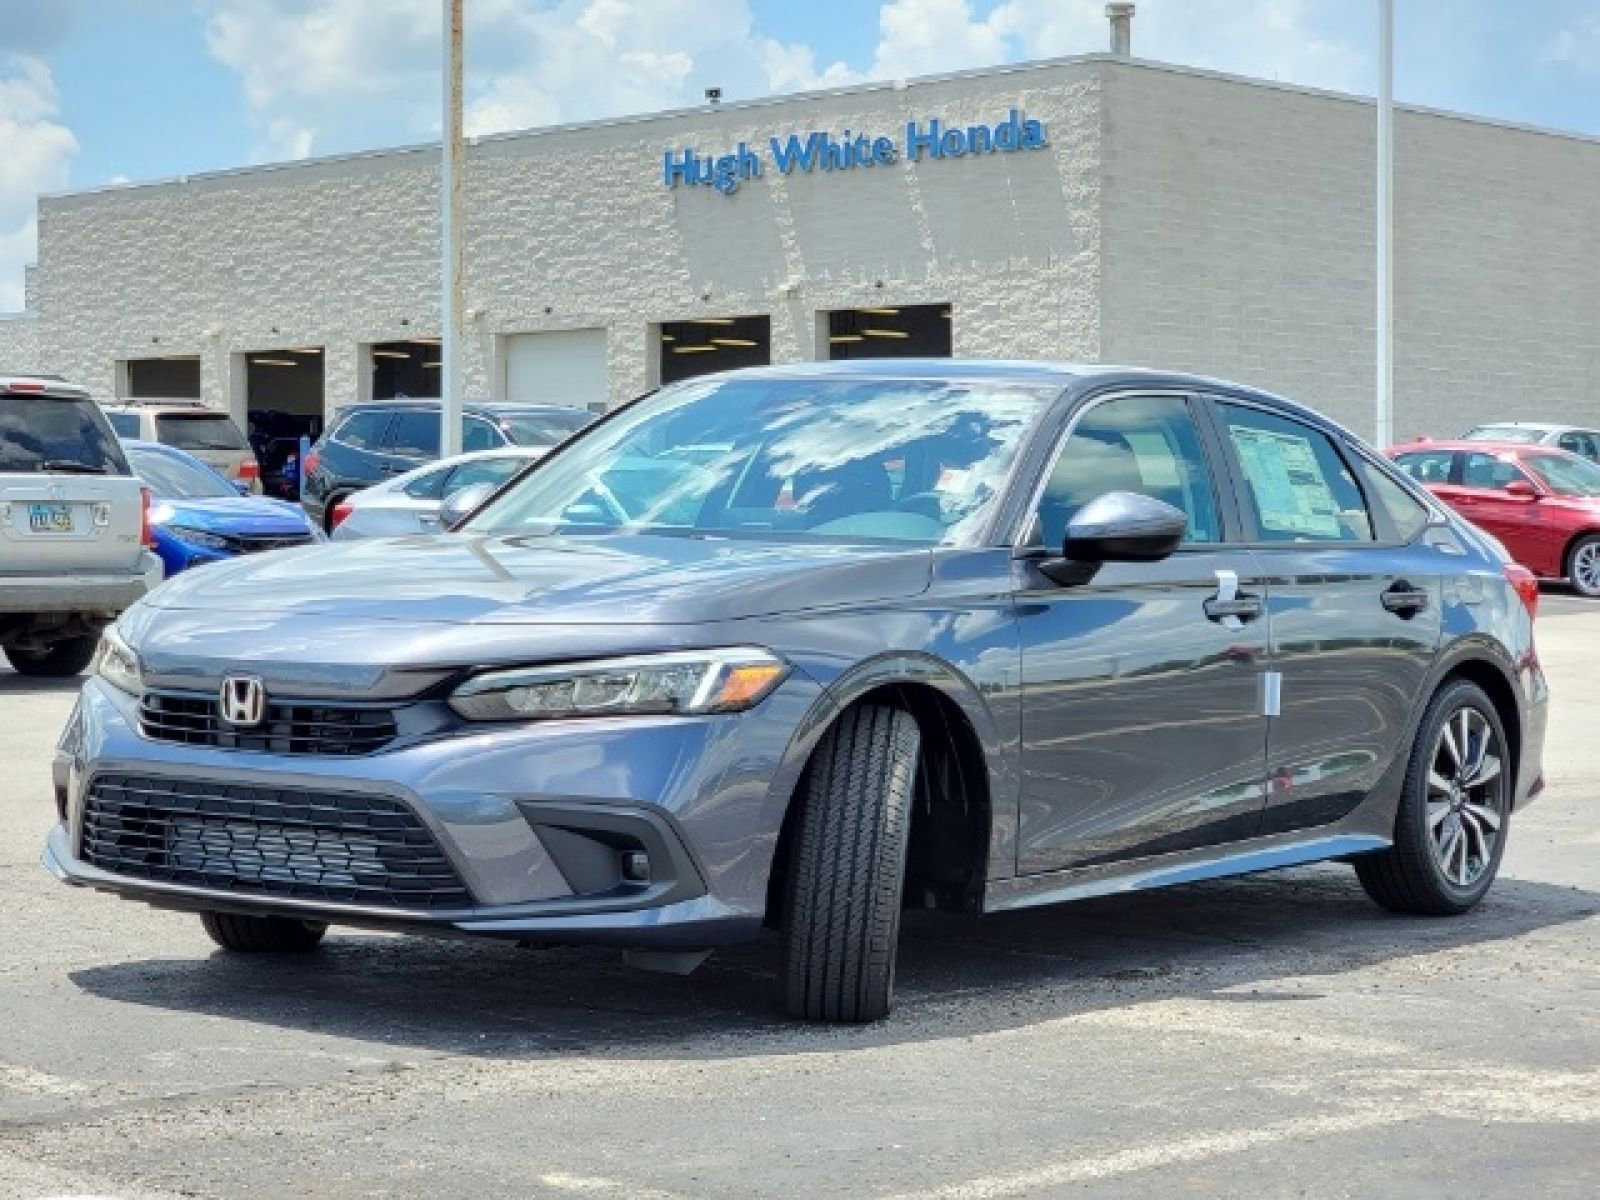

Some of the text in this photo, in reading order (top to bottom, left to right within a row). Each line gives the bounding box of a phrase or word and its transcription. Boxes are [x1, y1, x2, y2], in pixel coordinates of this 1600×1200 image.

[664, 107, 1047, 194] Hugh White Honda
